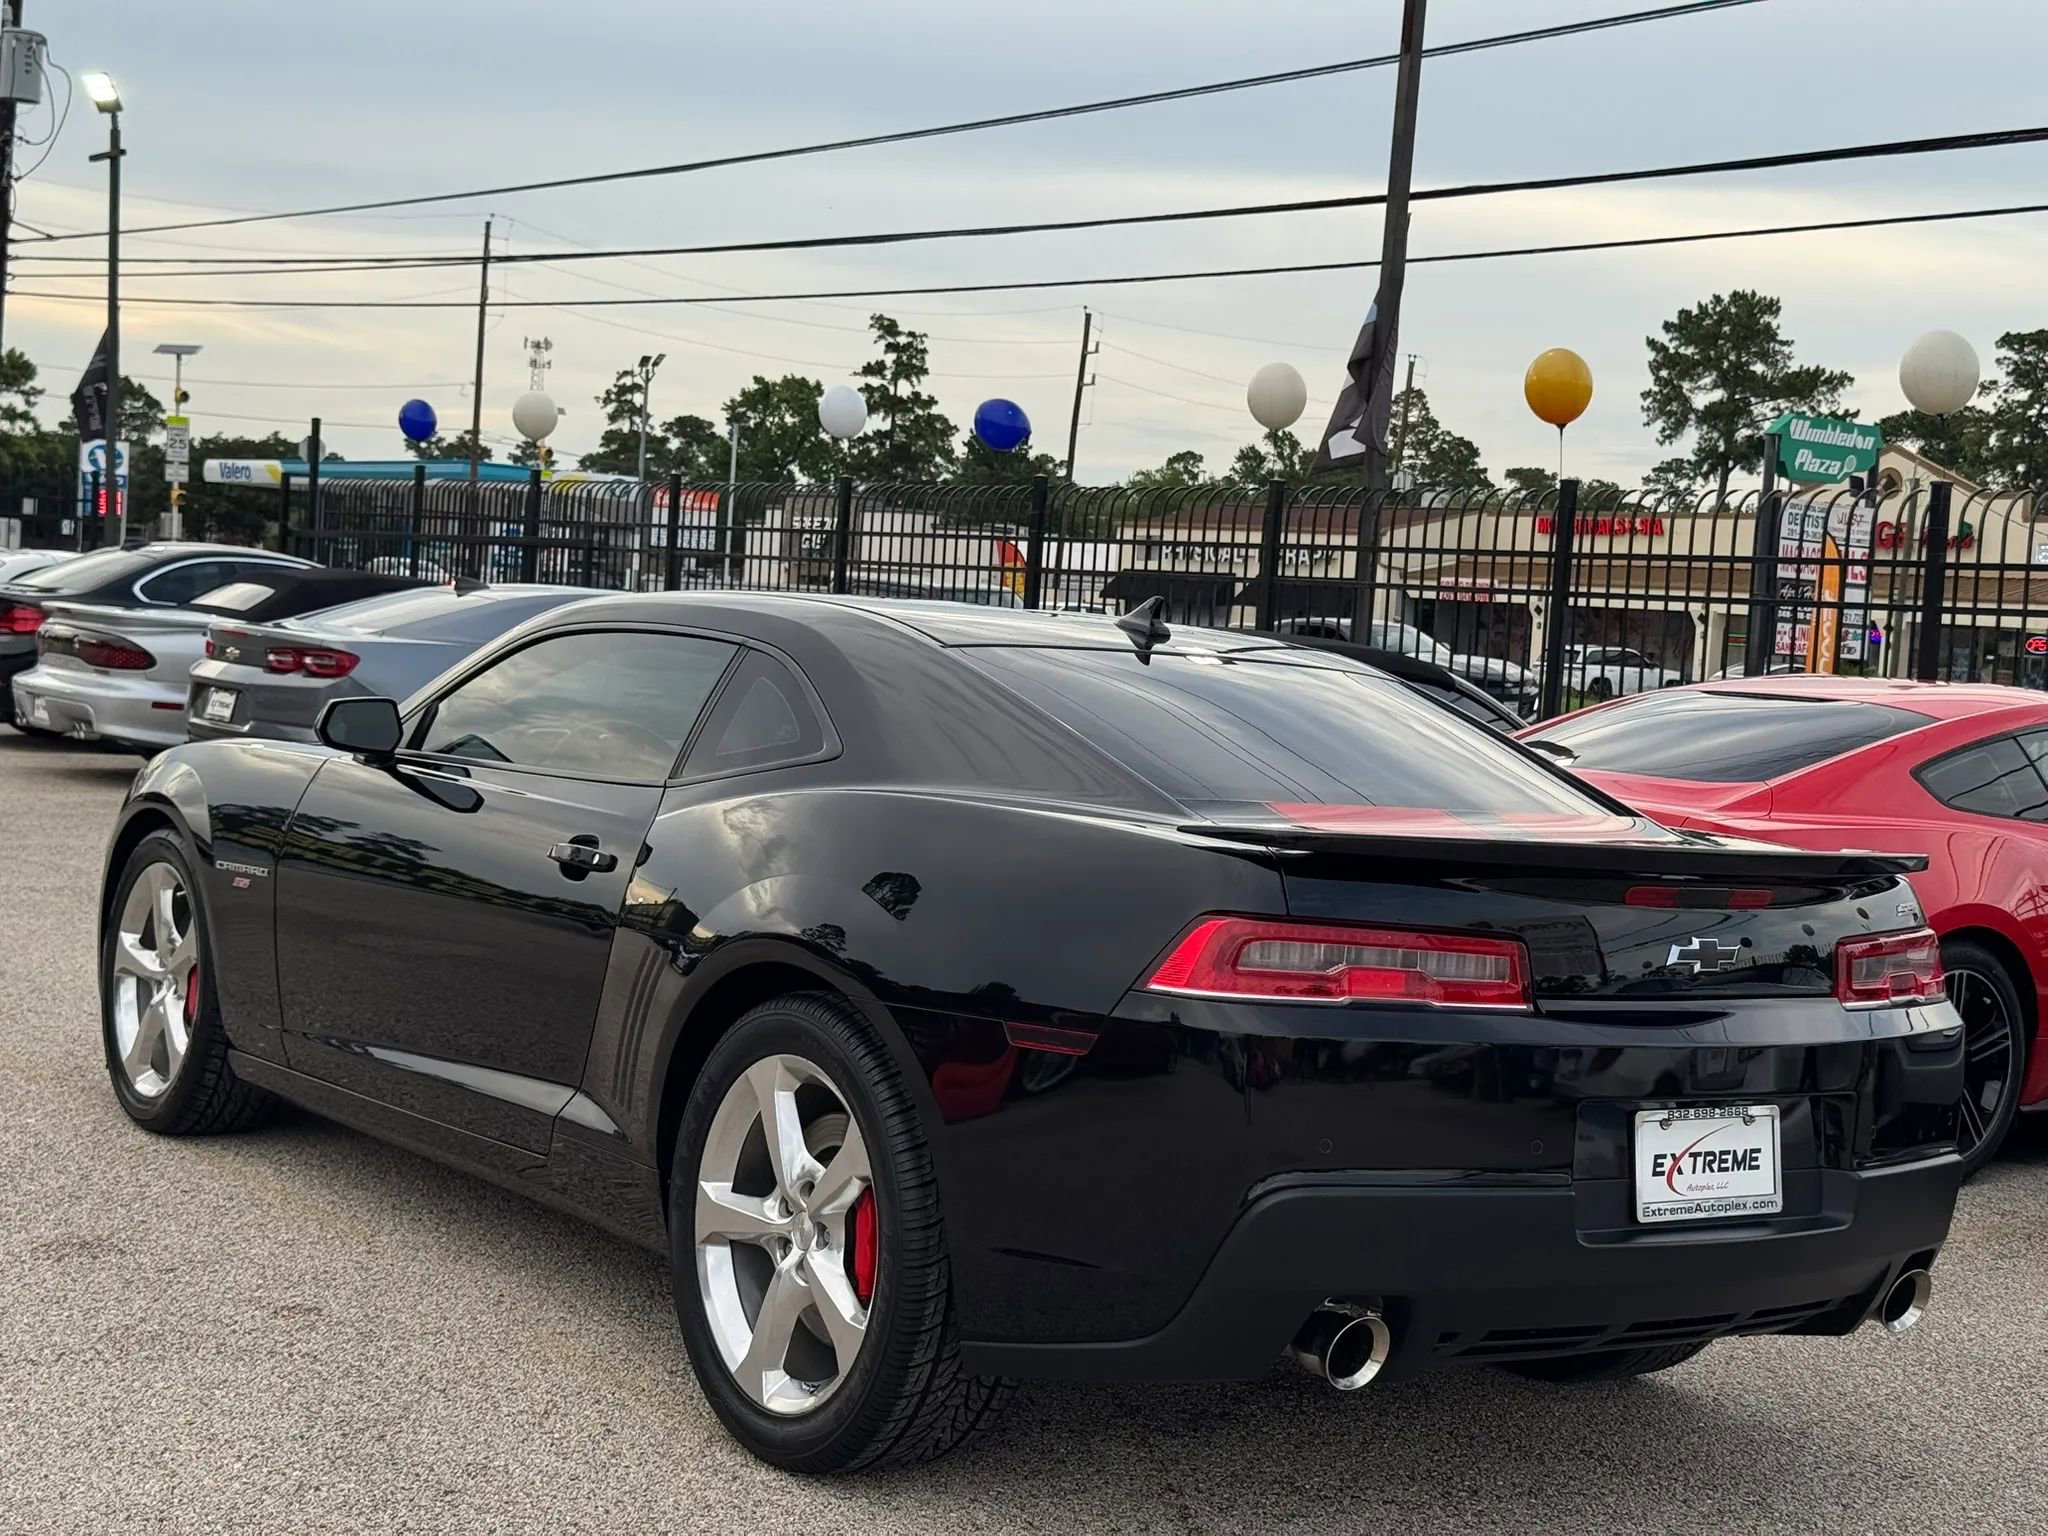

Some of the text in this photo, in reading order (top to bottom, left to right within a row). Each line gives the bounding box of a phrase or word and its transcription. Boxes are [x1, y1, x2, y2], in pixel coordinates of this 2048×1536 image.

[1790, 418, 1875, 450] Wimbledon
[169, 438, 187, 449] 25
[1795, 448, 1842, 475] Plaza
[219, 462, 251, 480] Valero
[216, 860, 269, 877] CAMARO
[1667, 1106, 1749, 1119] 832-698-2668
[1652, 1148, 1762, 1177] EXTREME
[1716, 1181, 1730, 1190] LLC
[1642, 1199, 1778, 1218] ExtremeAutoplex.com
